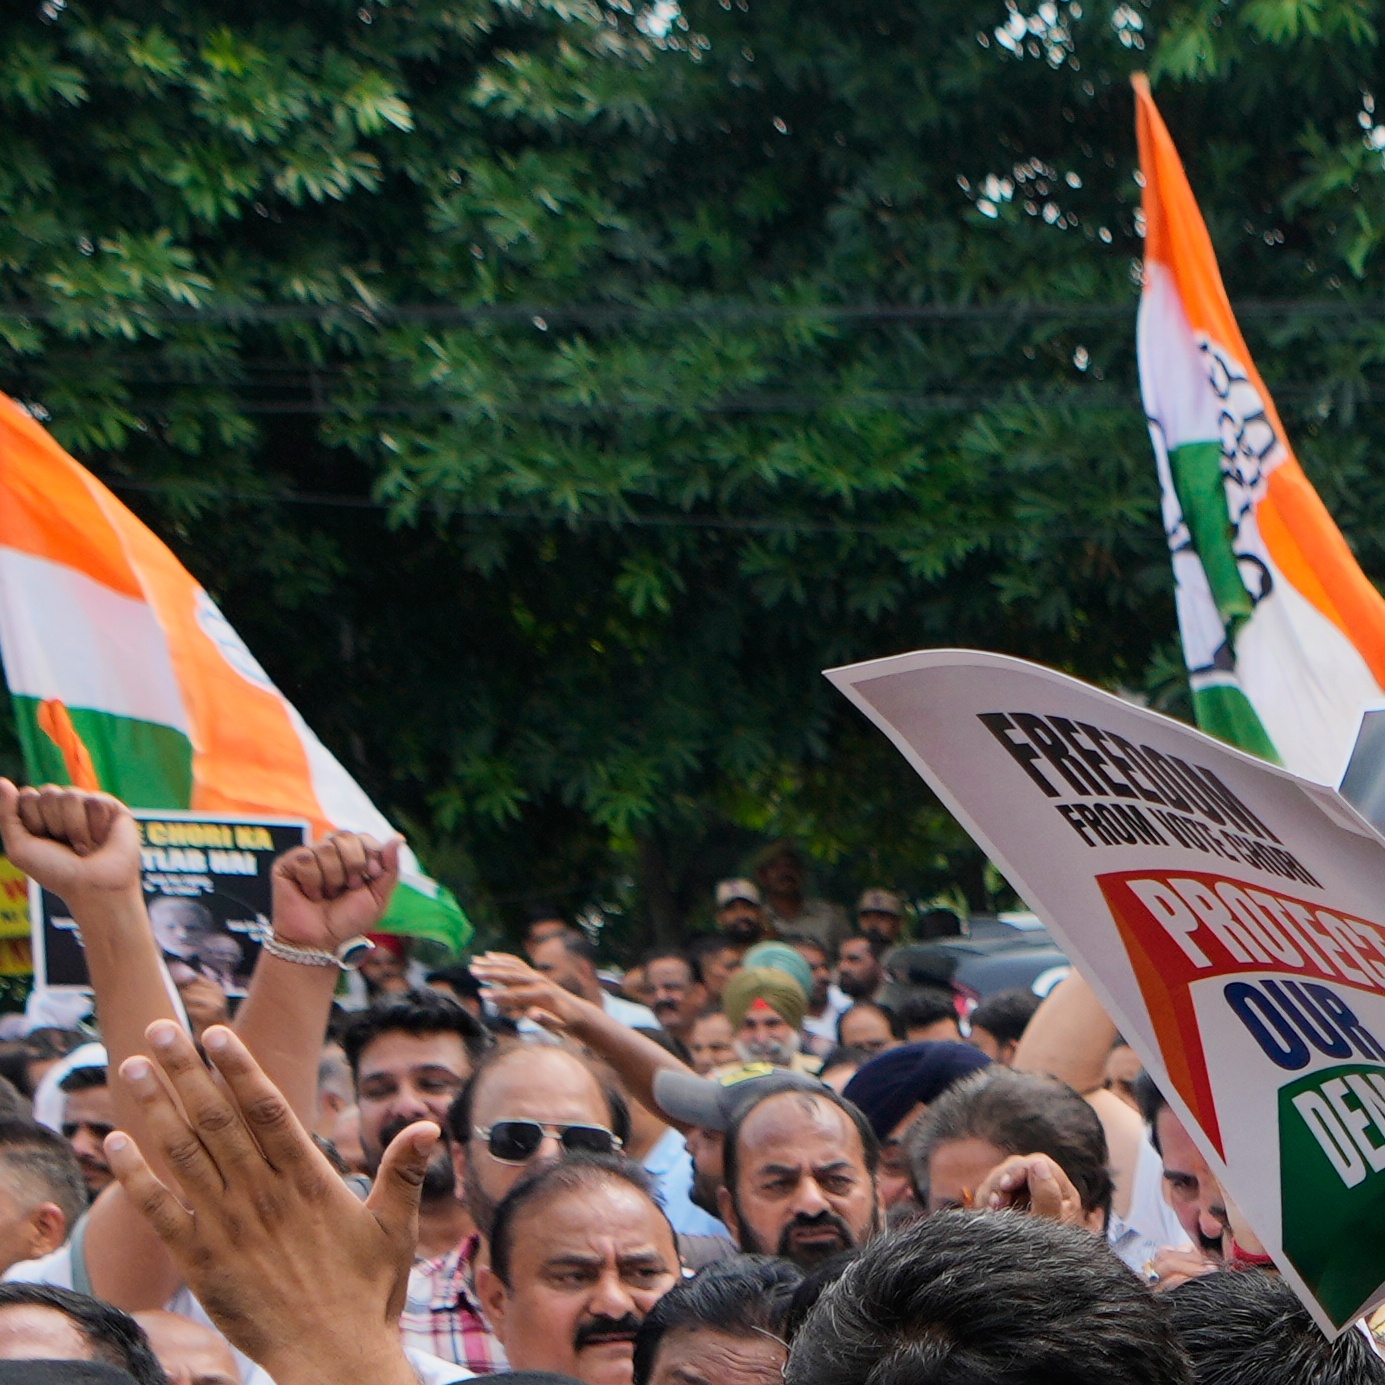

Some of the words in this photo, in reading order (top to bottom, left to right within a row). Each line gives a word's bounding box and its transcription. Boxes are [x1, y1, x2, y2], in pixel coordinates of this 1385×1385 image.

[976, 712, 1284, 845] FREEDOM
[1055, 803, 1170, 847] FROM
[1145, 807, 1241, 863] VOTE
[1219, 829, 1325, 890] CHORI
